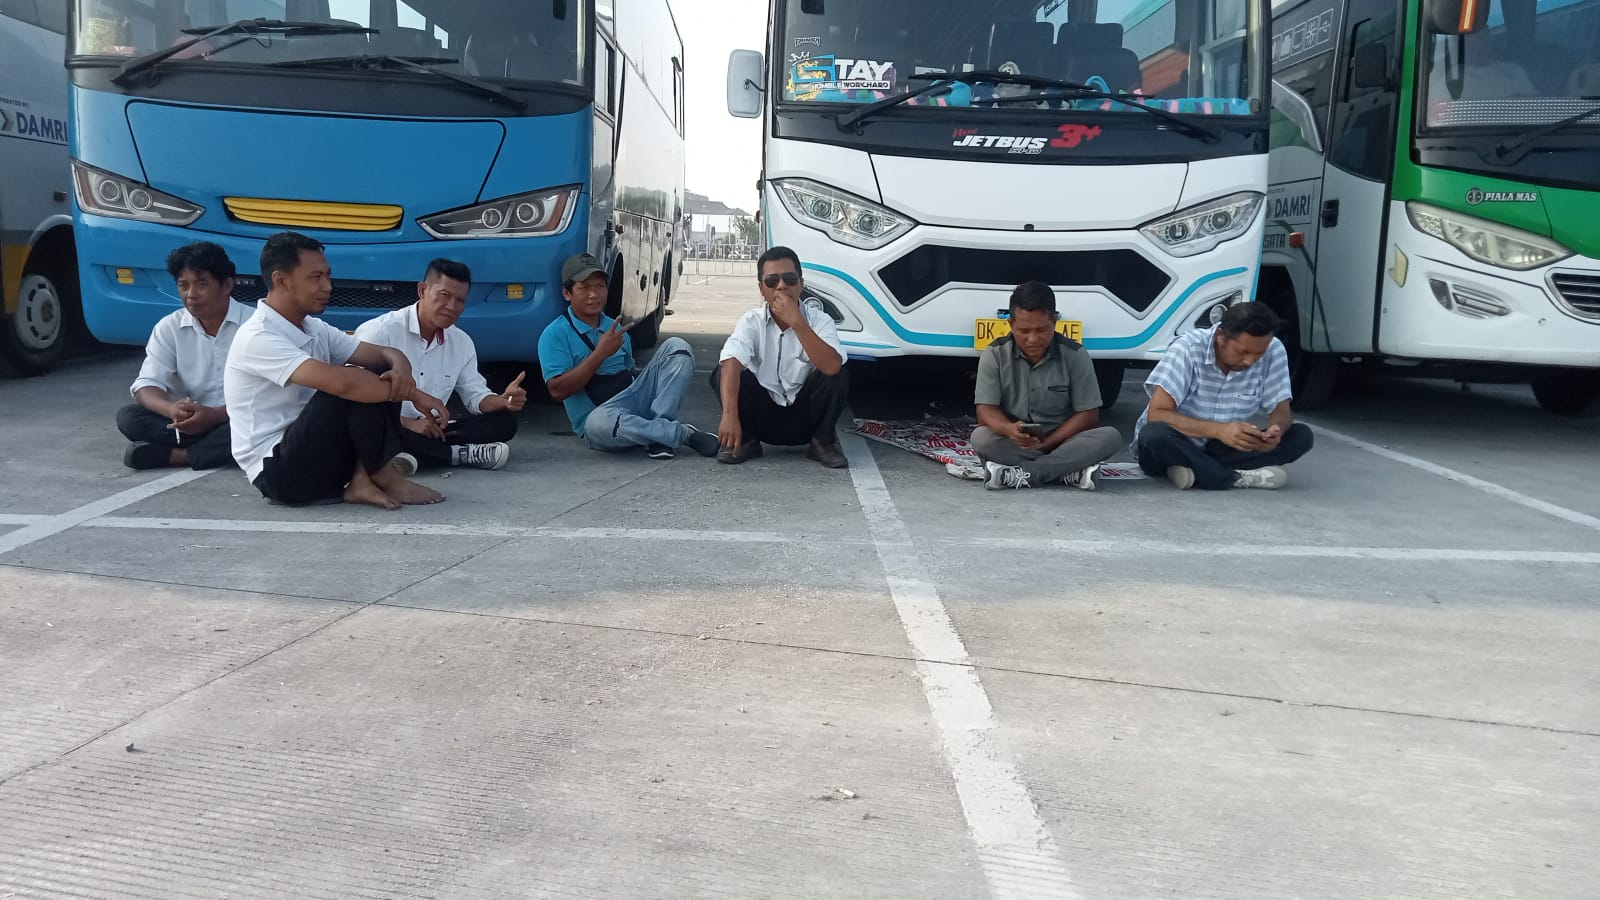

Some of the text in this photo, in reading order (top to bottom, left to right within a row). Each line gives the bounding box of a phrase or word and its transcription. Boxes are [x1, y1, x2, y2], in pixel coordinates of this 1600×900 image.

[790, 54, 893, 84] STAY
[16, 111, 69, 142] DAMRI
[952, 135, 1048, 149] JETBUS
[1274, 194, 1311, 218] DAMRI
[1485, 192, 1537, 201] PIALA MAS
[977, 322, 994, 339] DK
